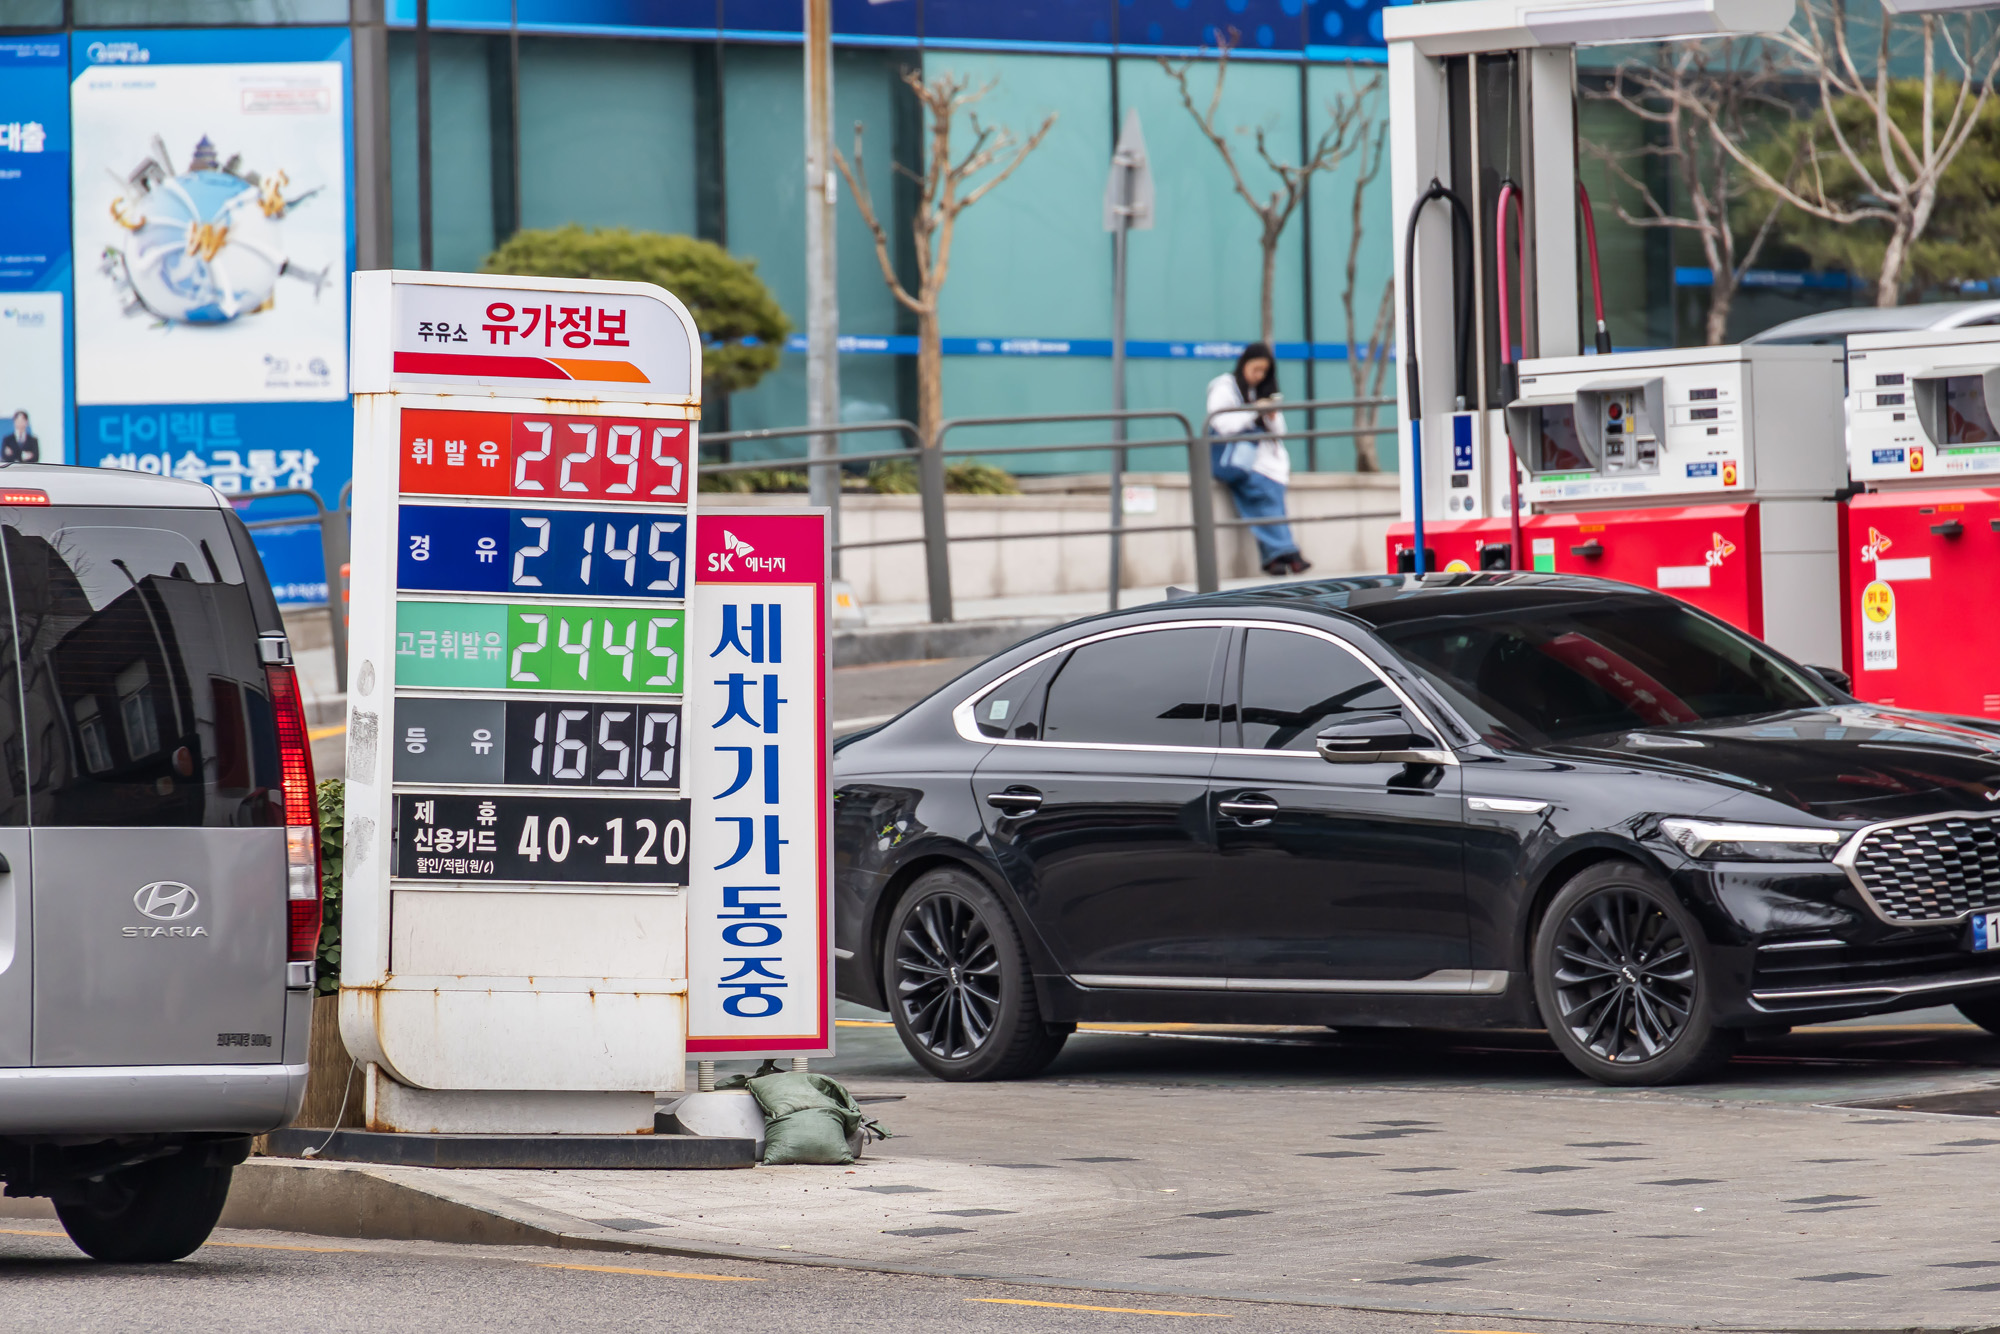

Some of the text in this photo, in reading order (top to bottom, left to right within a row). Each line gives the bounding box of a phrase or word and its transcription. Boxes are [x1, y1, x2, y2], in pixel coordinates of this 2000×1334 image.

[417, 302, 630, 349] 주유소 유가정보
[99, 411, 242, 452] 다이렉트
[514, 420, 684, 496] 2295
[511, 516, 682, 591] 2145
[707, 552, 786, 573] SK 에너지
[1705, 550, 1723, 566] SK
[1861, 545, 1879, 562] SK
[396, 613, 680, 686] 고급휘발유 2445
[531, 709, 679, 781] 1650
[414, 828, 497, 853] 신용카드
[121, 926, 209, 938] STARIA
